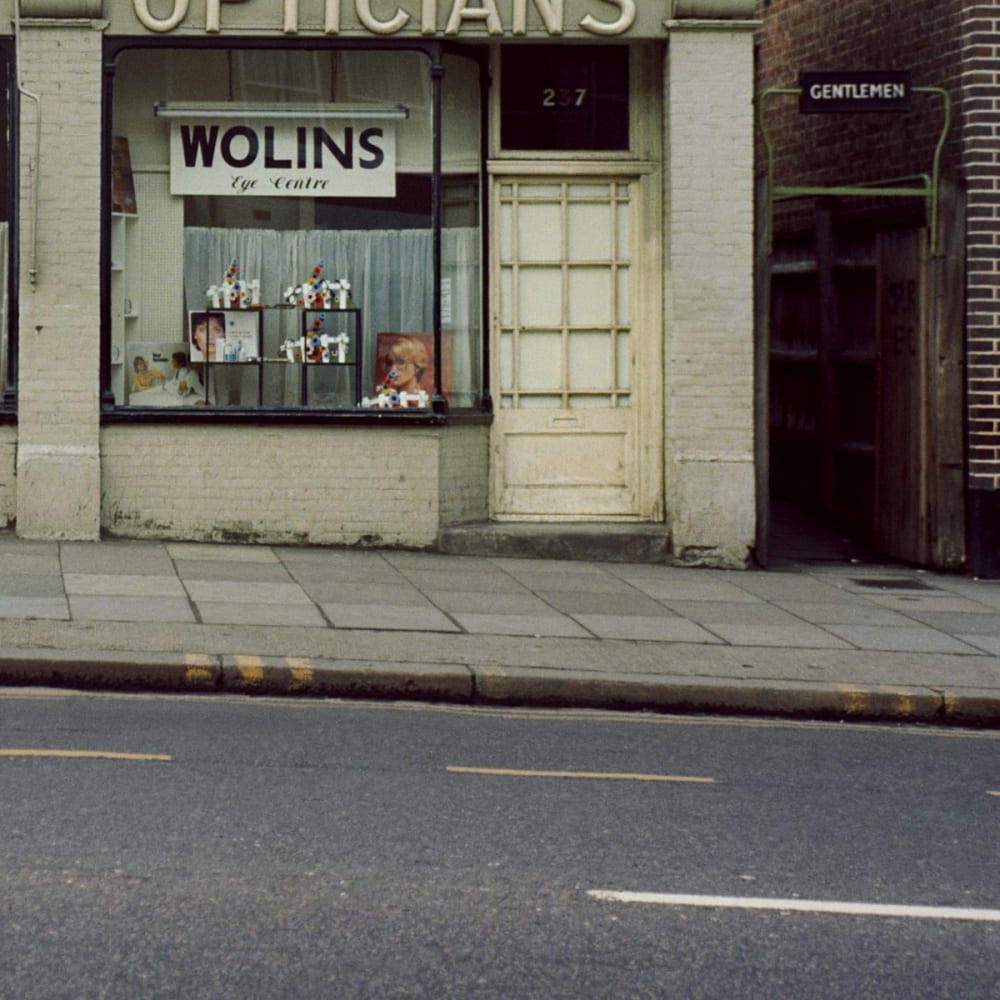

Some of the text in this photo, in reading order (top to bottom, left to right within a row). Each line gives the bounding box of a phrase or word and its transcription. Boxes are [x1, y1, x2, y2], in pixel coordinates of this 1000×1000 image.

[809, 83, 905, 100] GENTLEMEN
[180, 124, 385, 170] WOLINS
[230, 175, 331, 193] Eye Centre
